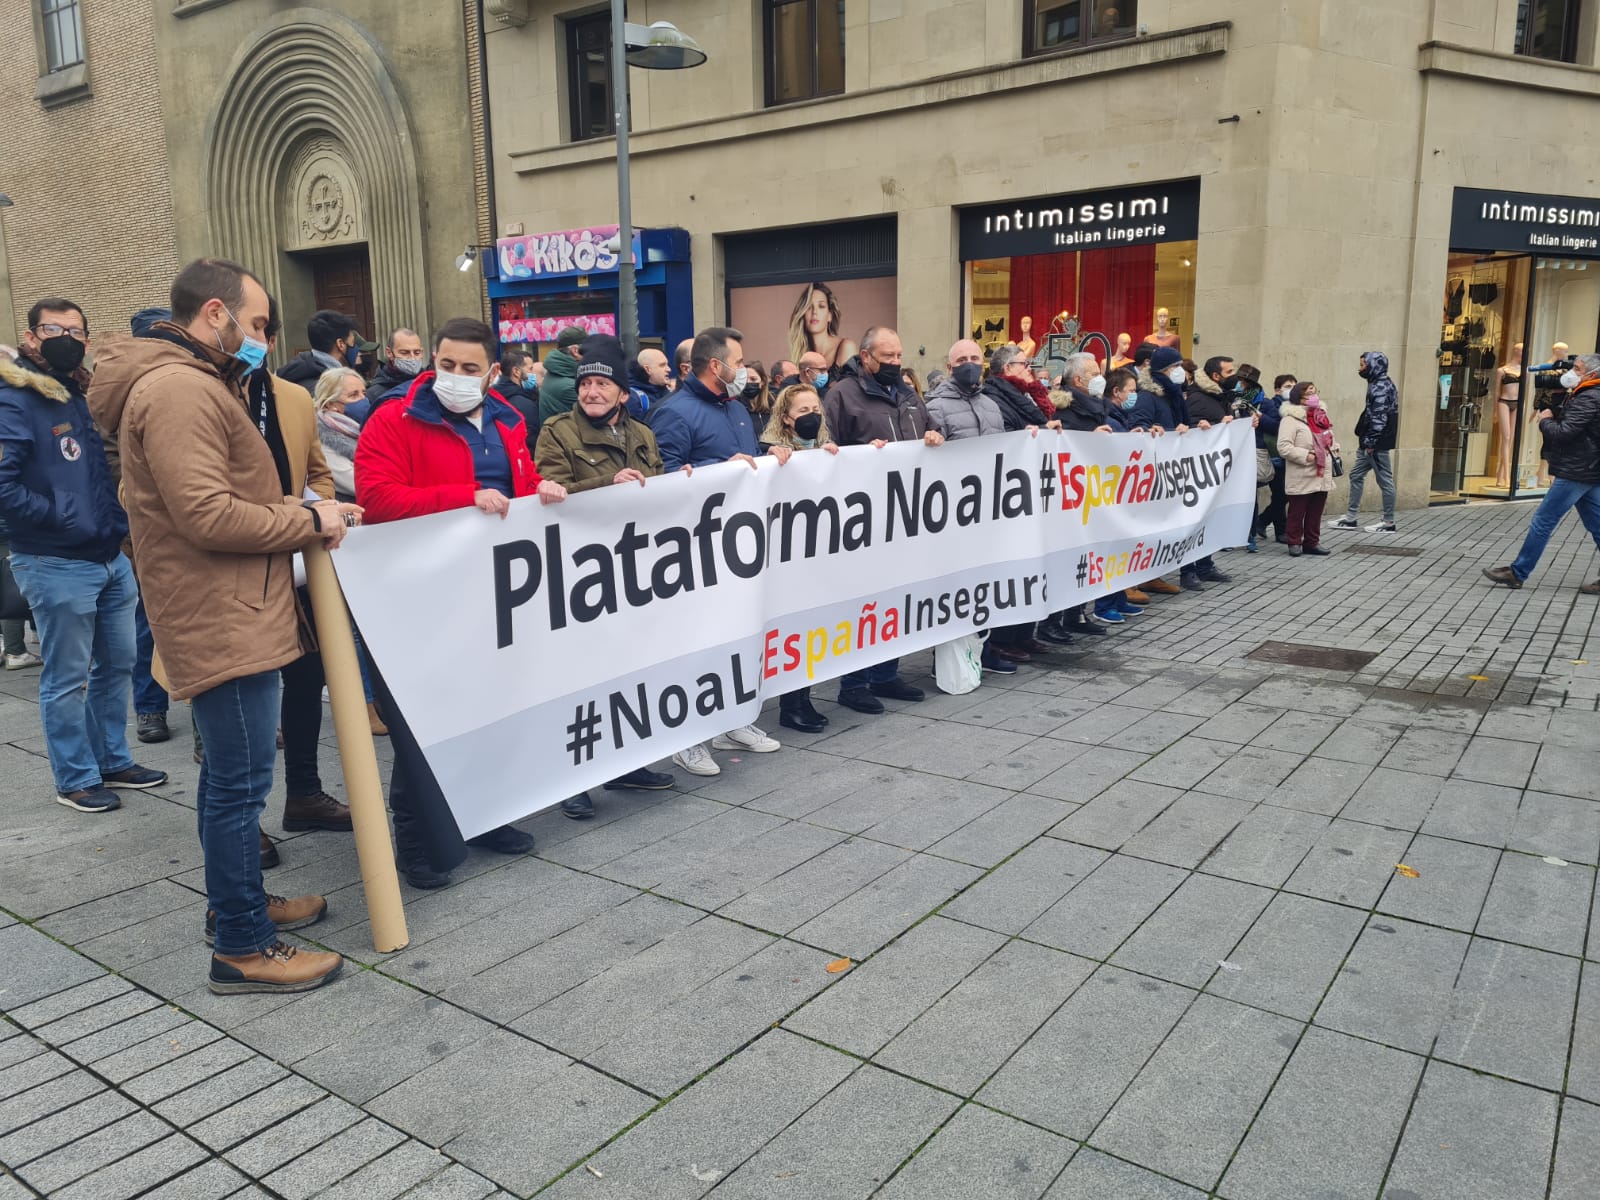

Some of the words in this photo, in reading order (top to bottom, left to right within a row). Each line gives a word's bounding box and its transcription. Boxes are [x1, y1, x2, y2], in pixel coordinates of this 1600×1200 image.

[1055, 231, 1101, 245] Italian
[1107, 223, 1166, 241] lingerie
[1530, 232, 1560, 247] Italian
[1562, 235, 1598, 249] lingerie
[493, 490, 872, 649] Plataforma
[885, 467, 949, 542] No
[956, 474, 982, 527] a
[992, 453, 1033, 520] la
[1040, 448, 1233, 526] #EspañaInsegura
